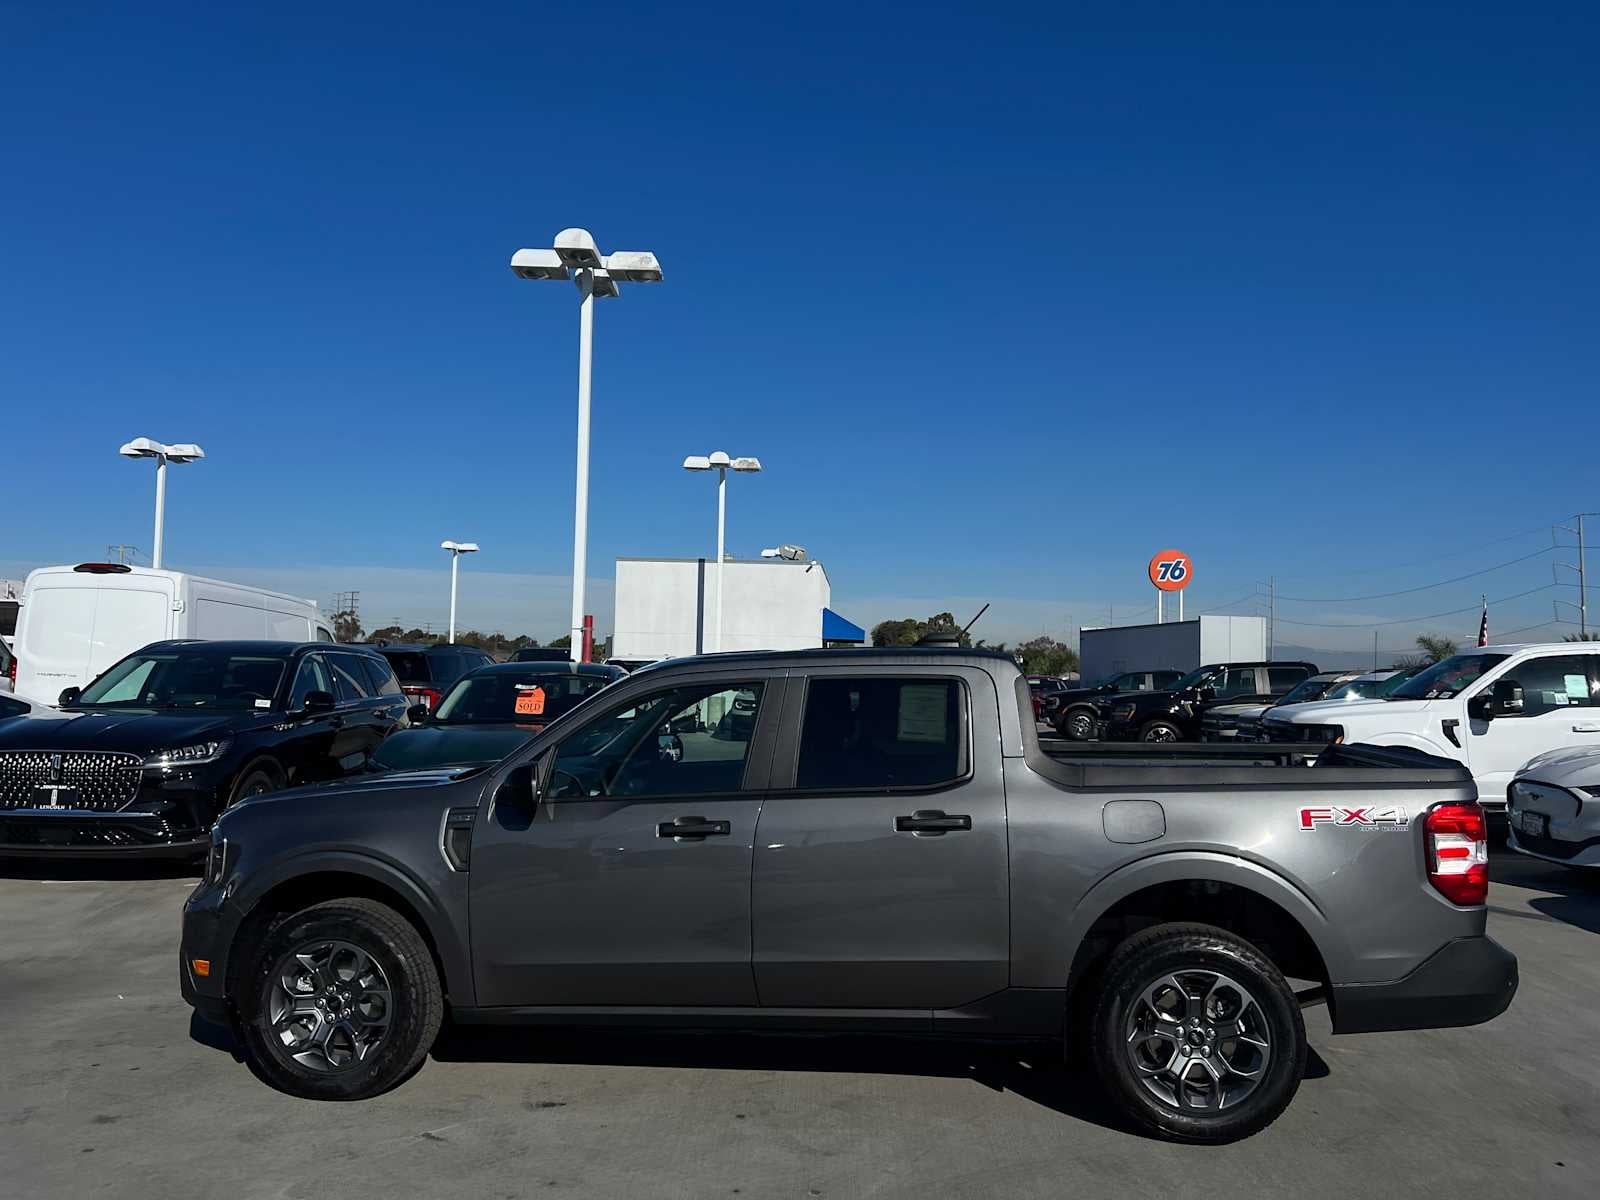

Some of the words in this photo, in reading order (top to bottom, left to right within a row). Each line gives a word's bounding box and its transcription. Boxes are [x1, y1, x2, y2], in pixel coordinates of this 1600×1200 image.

[1157, 559, 1186, 582] 76
[519, 702, 541, 712] SOLD
[1298, 805, 1409, 831] FX4
